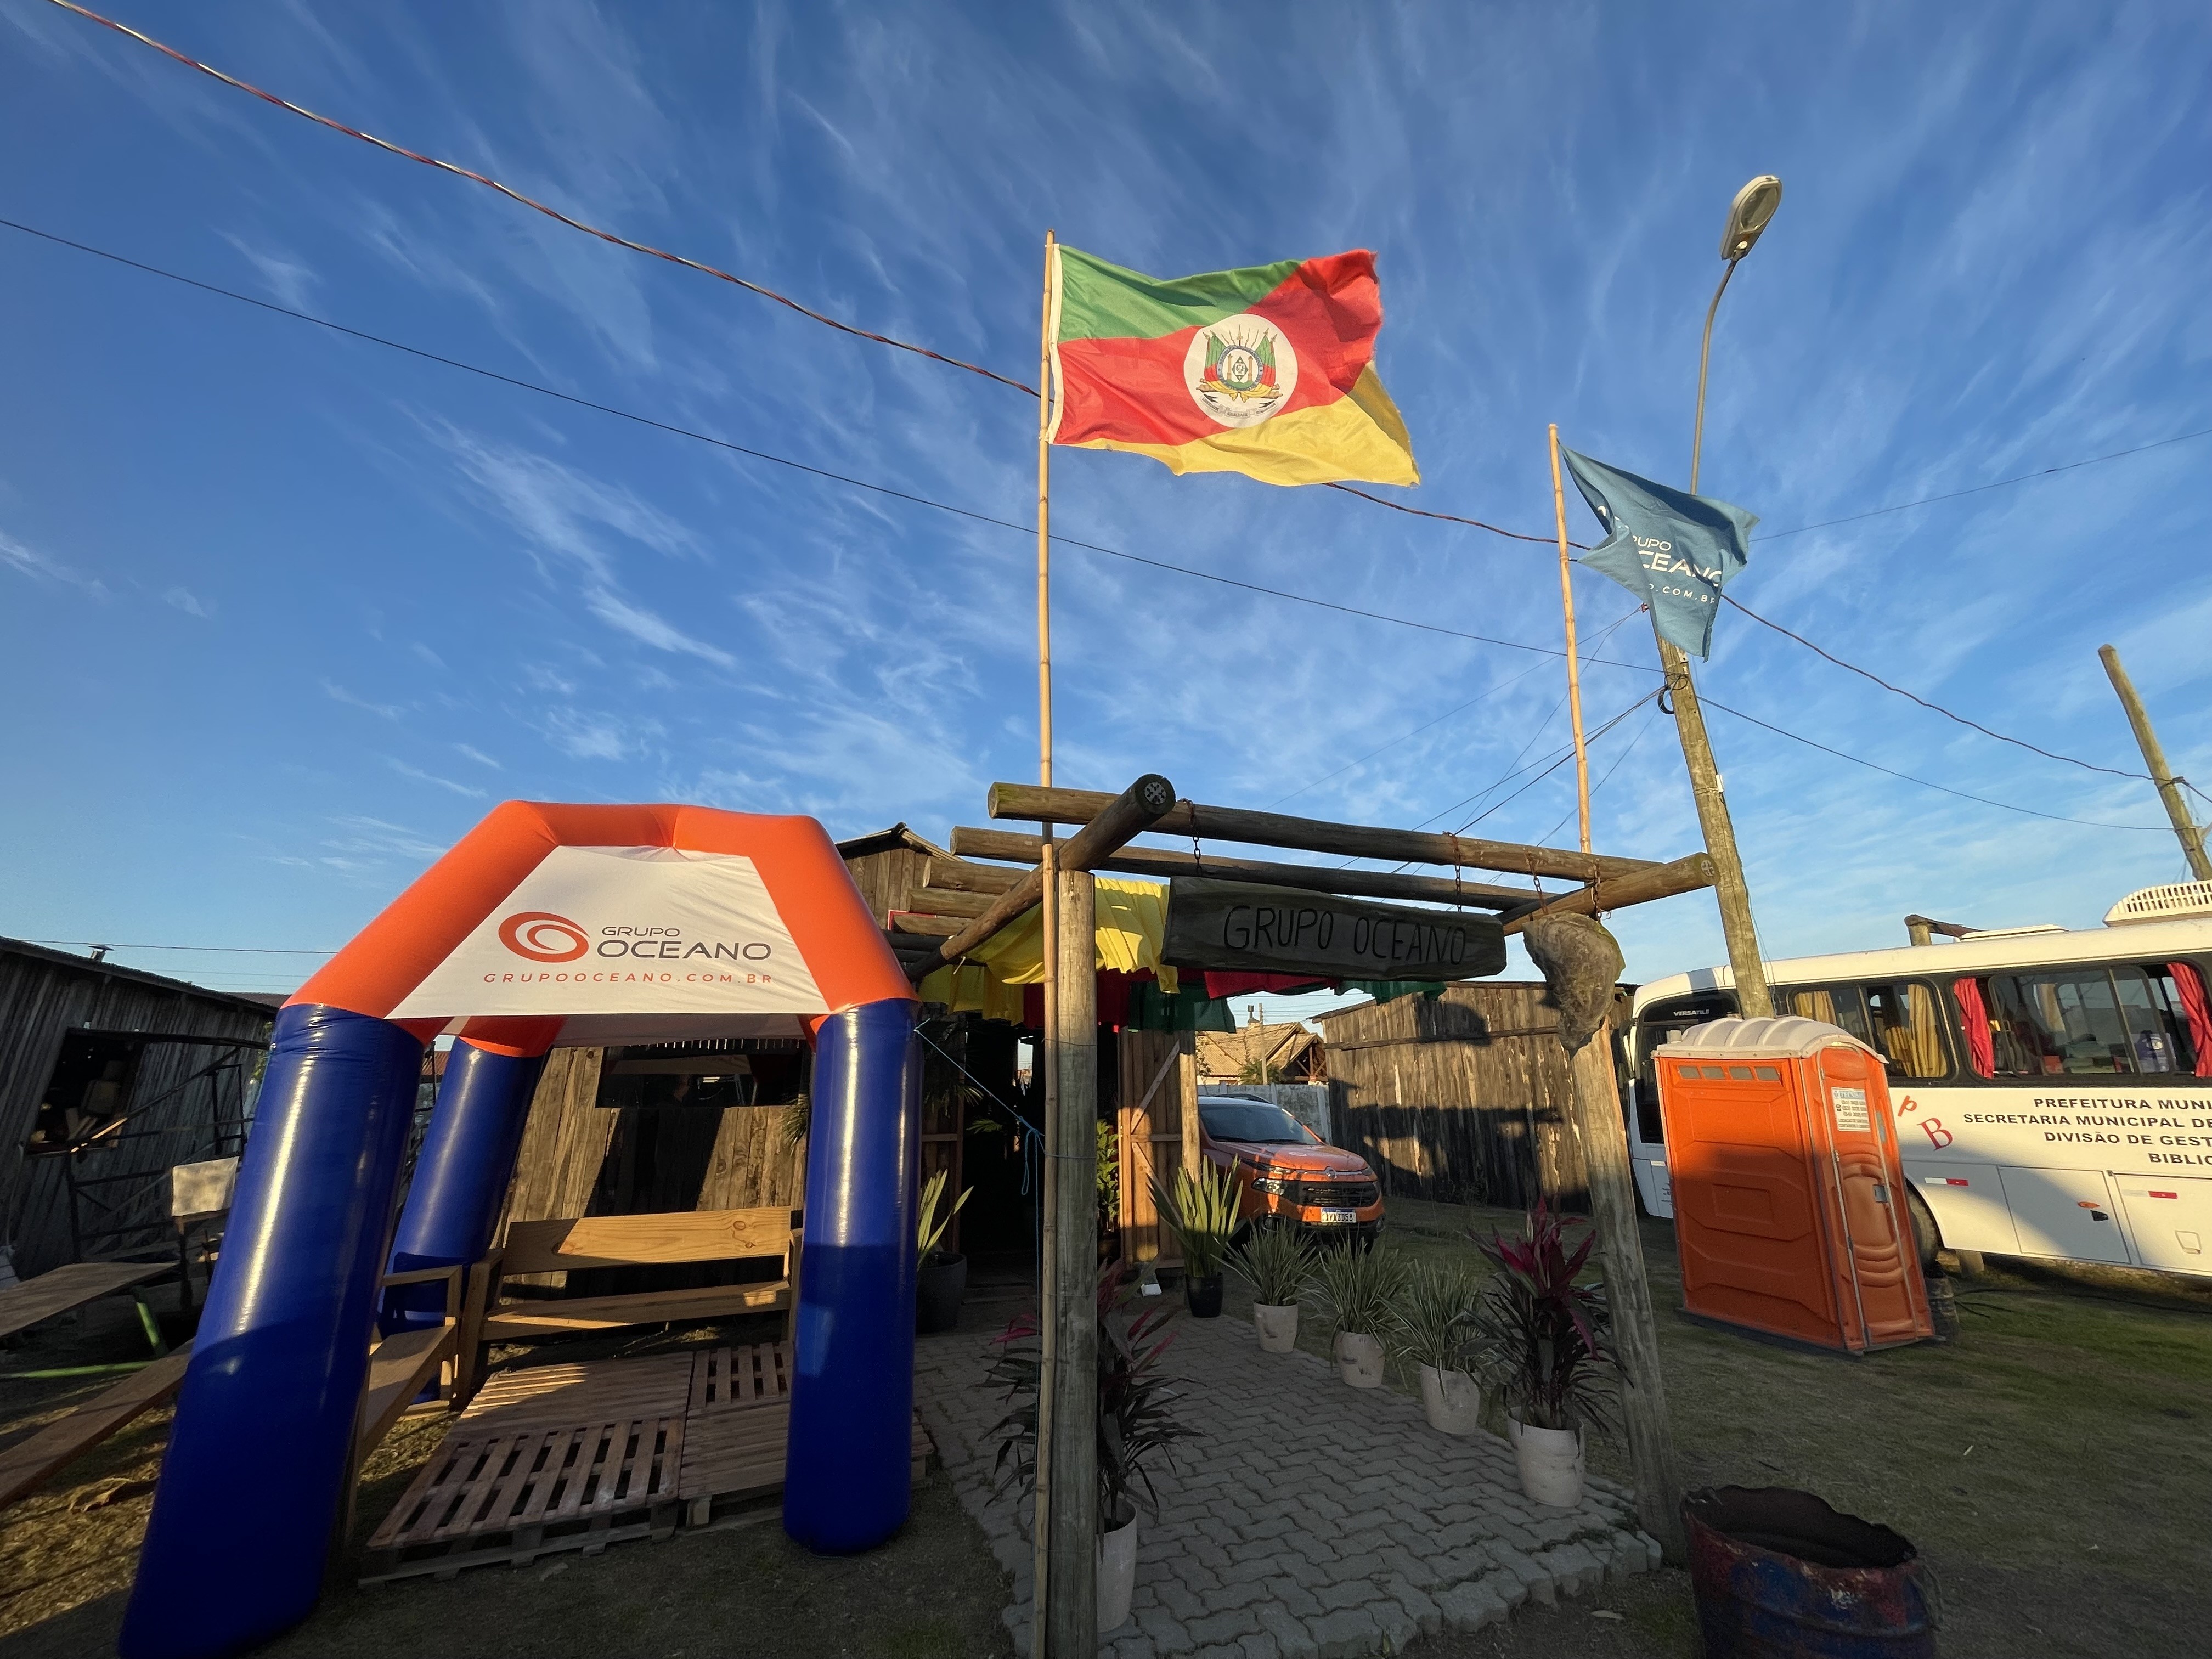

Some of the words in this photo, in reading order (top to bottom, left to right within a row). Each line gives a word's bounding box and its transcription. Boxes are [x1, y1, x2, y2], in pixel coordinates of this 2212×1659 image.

[601, 926, 681, 938] GRUPO
[1223, 905, 1334, 951] GRUPO
[1353, 916, 1466, 966] OCEANO
[596, 939, 772, 961] OCEANO
[483, 973, 772, 984] GRUPOOCEANO.COM.BR
[2033, 1098, 2152, 1109] PREFEITURA
[2157, 1099, 2212, 1110] MUNI
[1963, 1114, 2072, 1125] SECRETARIA
[2075, 1116, 2186, 1128] MUNICIPAL
[1916, 1118, 1953, 1152] B
[2044, 1131, 2120, 1143] DIVISÃO
[2126, 1134, 2154, 1145] DE
[2159, 1135, 2212, 1147] GEST
